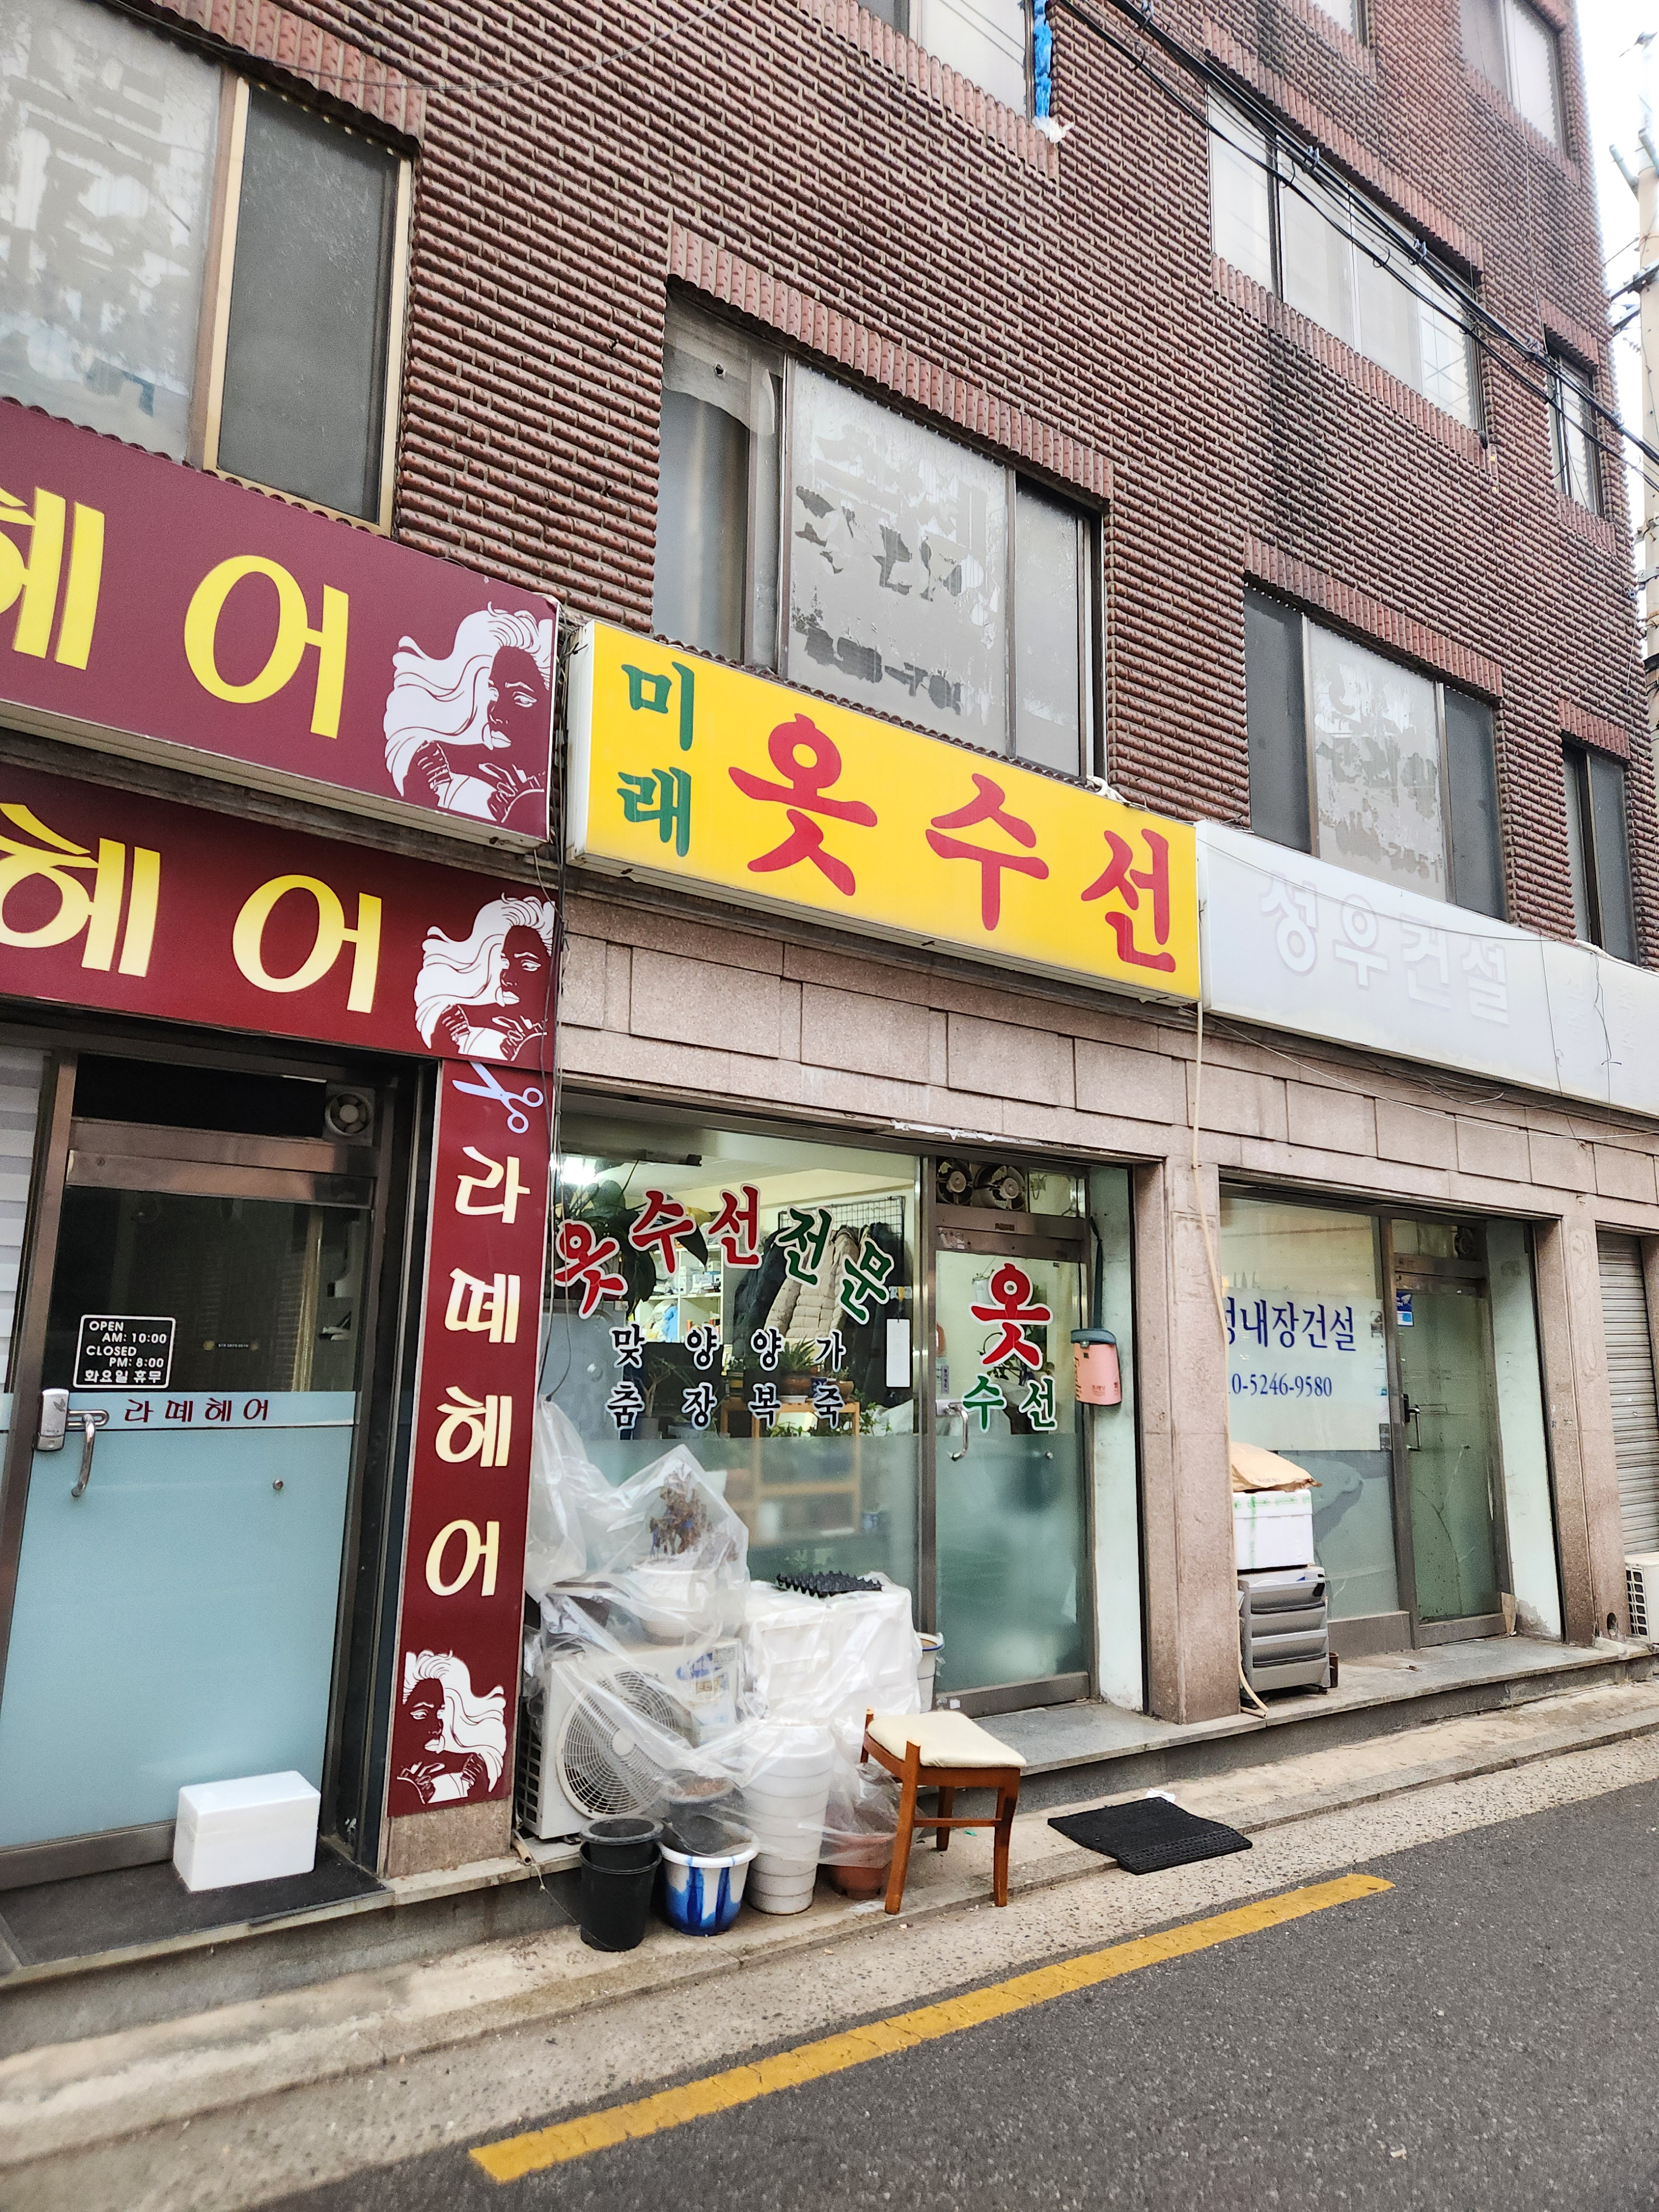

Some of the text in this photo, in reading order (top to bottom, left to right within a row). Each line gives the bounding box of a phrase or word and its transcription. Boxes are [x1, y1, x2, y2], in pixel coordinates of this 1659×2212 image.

[617, 661, 694, 857] 미래
[728, 713, 1176, 972] 옷수선
[1259, 870, 1510, 1028] 성우건설
[777, 1206, 894, 1324] 전문
[89, 1321, 124, 1331] OPEN
[970, 1262, 1052, 1369] 옷
[86, 1345, 137, 1357] CLOSED
[102, 1332, 167, 1344] AM: 10:00
[84, 1369, 161, 1383] 화요일 휴무
[109, 1357, 164, 1368] PM: 8:00
[962, 1374, 1057, 1433] 수선
[1228, 1372, 1333, 1398] 0-5246-9580
